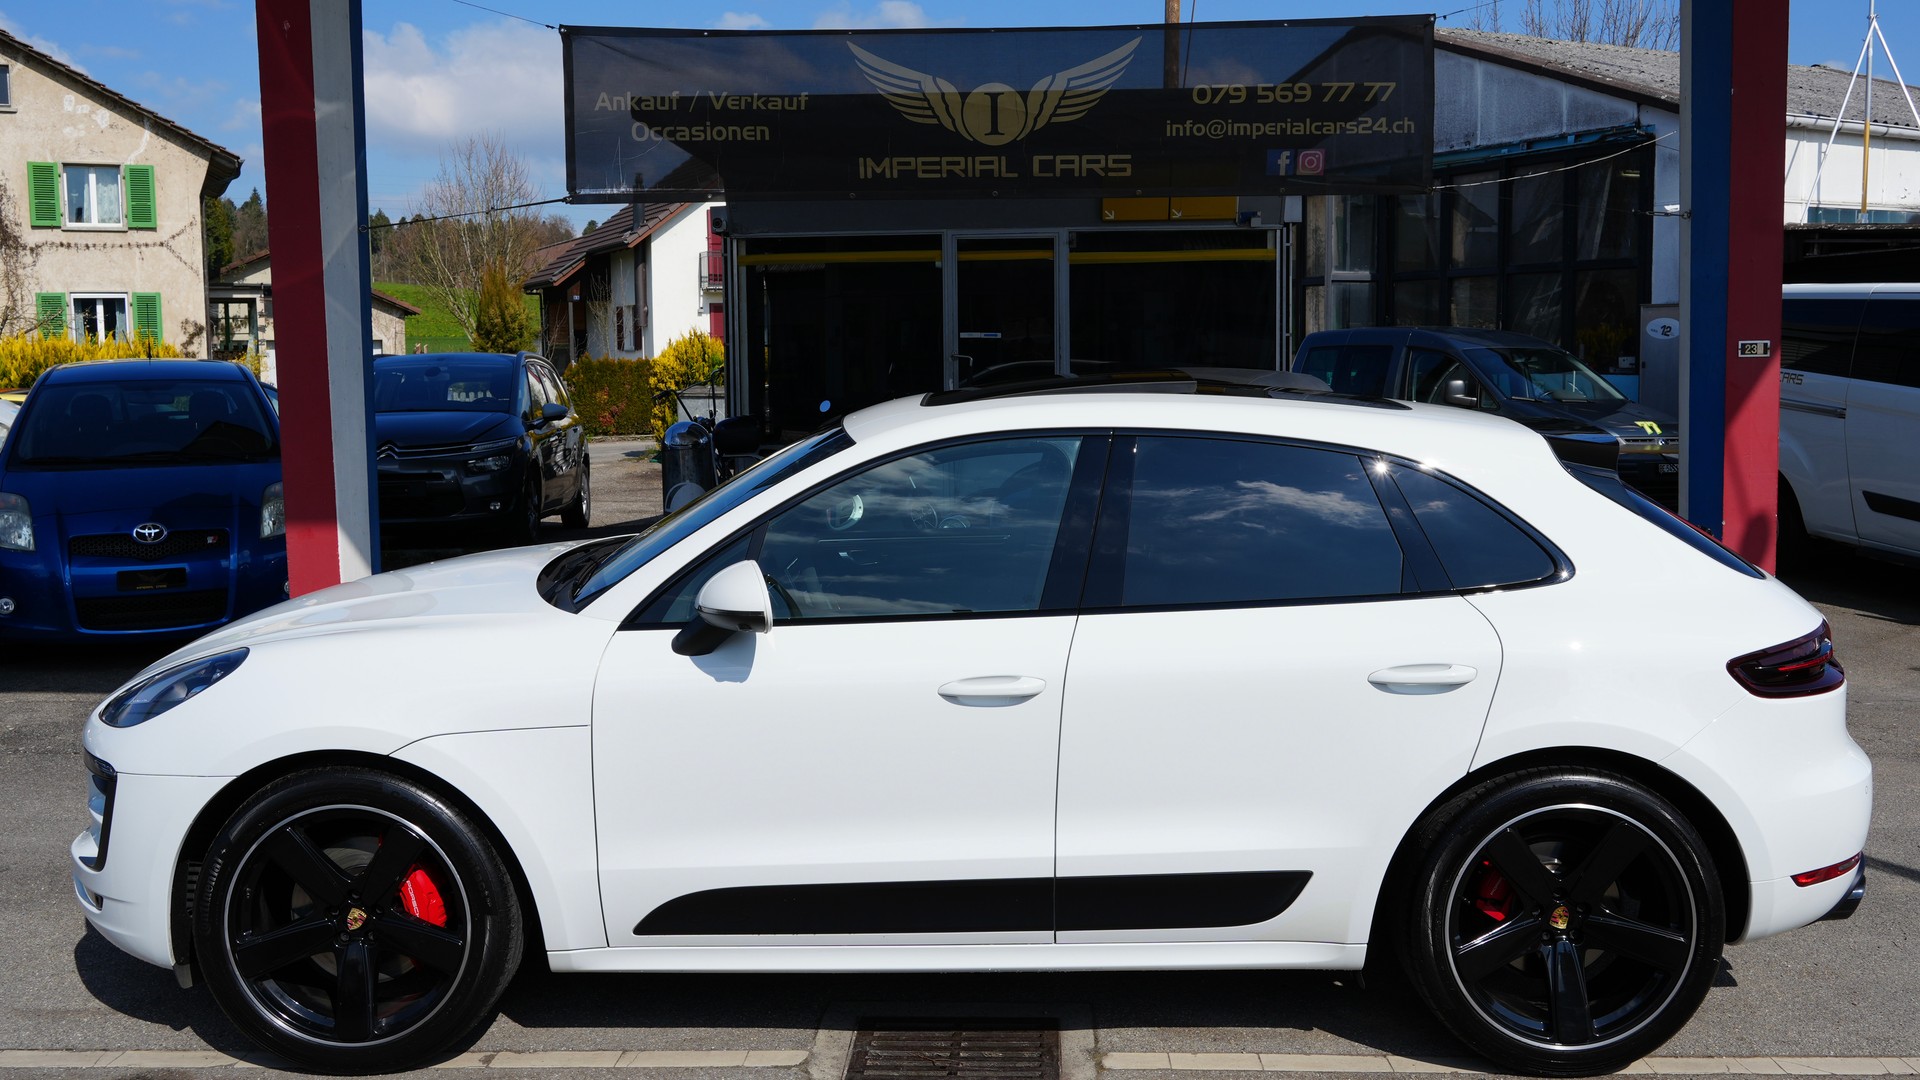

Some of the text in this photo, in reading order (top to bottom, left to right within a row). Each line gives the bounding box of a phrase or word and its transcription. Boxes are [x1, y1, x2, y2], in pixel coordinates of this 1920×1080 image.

[594, 91, 680, 111] Ankauf
[708, 91, 809, 111] Verkauf
[1192, 82, 1397, 104] 079 569 77 77
[631, 121, 770, 142] Occasionen
[1166, 116, 1415, 139] info@imperialcars24.ch
[858, 154, 1132, 179] IMPERIAL CARS
[1660, 324, 1672, 337] 12
[406, 880, 420, 918] PORSC
